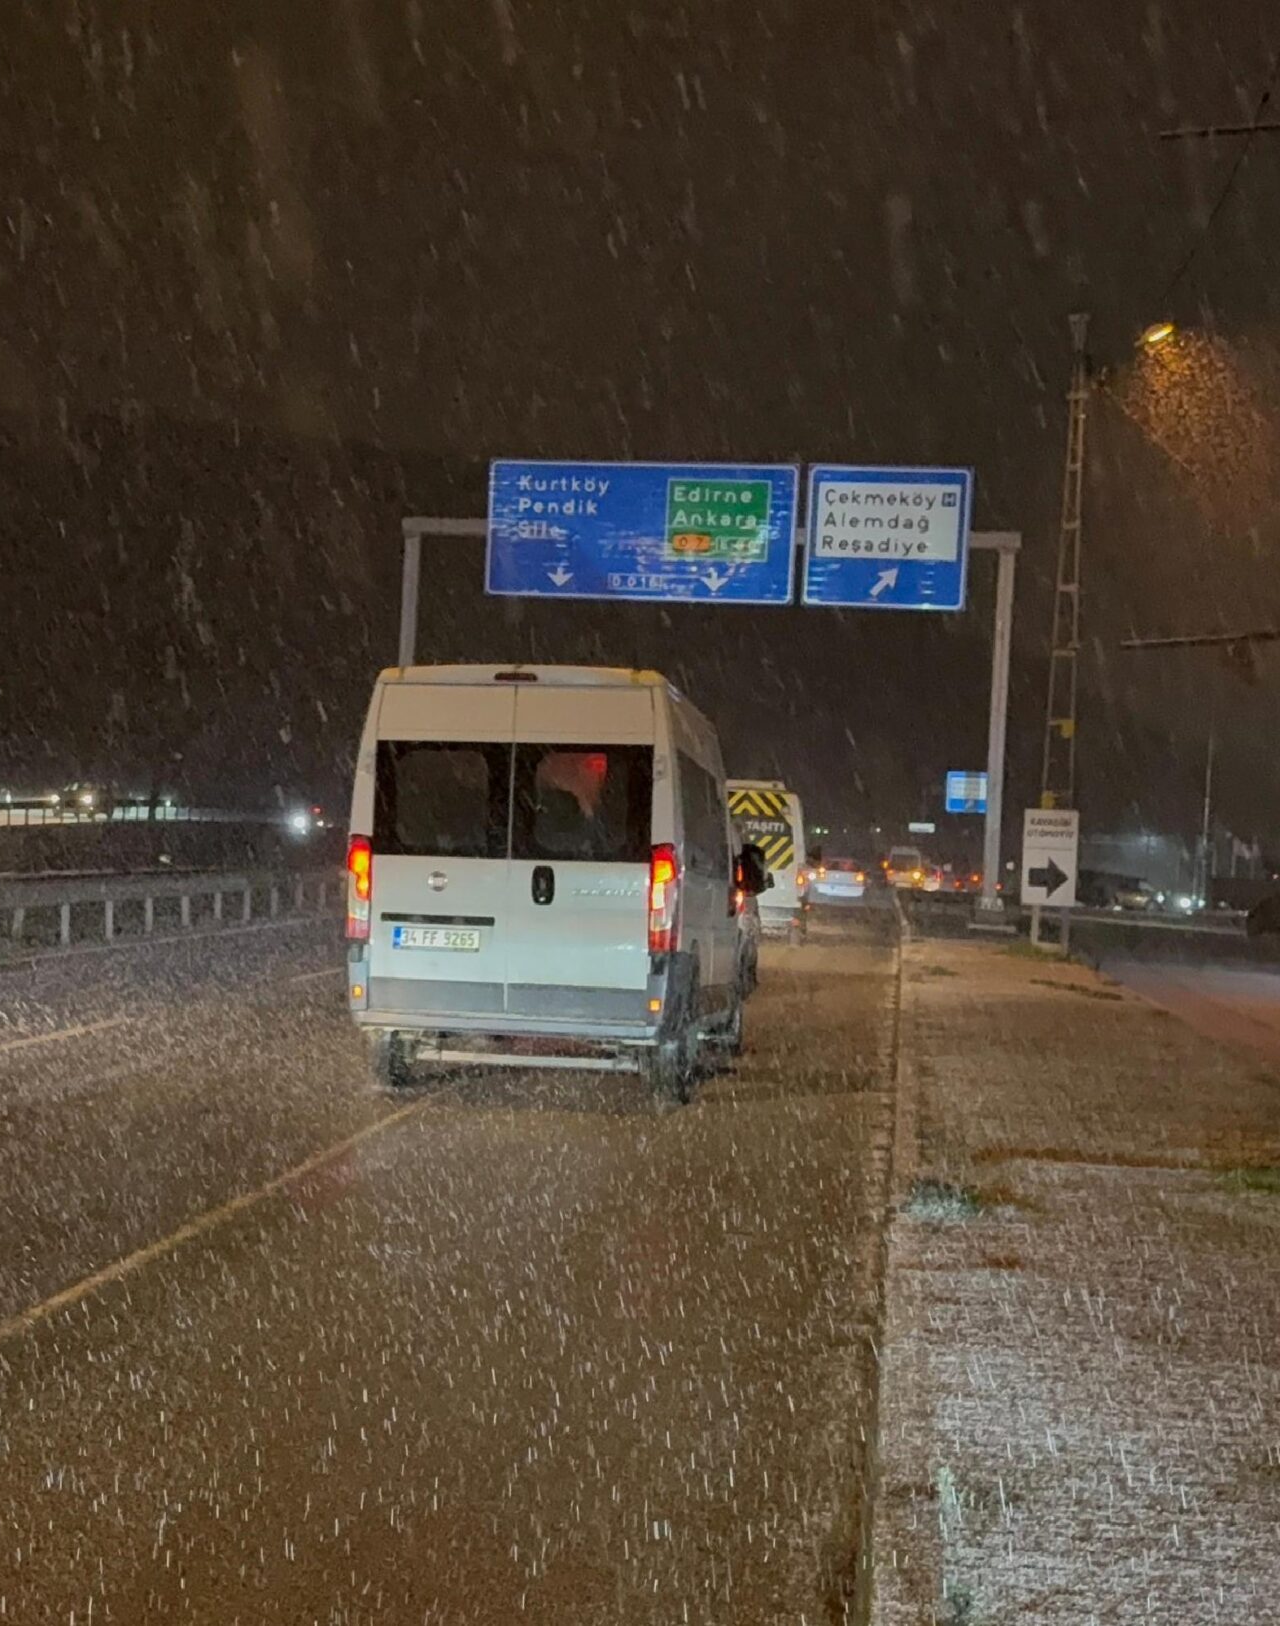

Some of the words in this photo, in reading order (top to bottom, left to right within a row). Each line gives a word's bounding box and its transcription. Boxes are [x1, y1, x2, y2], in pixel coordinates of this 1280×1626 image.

[519, 475, 610, 497] Kurtköy
[673, 486, 752, 503] Edirne
[518, 497, 598, 515] Pendik
[824, 489, 936, 511] Çekmeköy
[671, 509, 757, 528] Ankara
[823, 512, 930, 534] Alemdağ
[821, 535, 929, 557] Reşadiye
[403, 930, 417, 944] 34
[423, 930, 438, 945] FF
[444, 931, 475, 947] 9265
